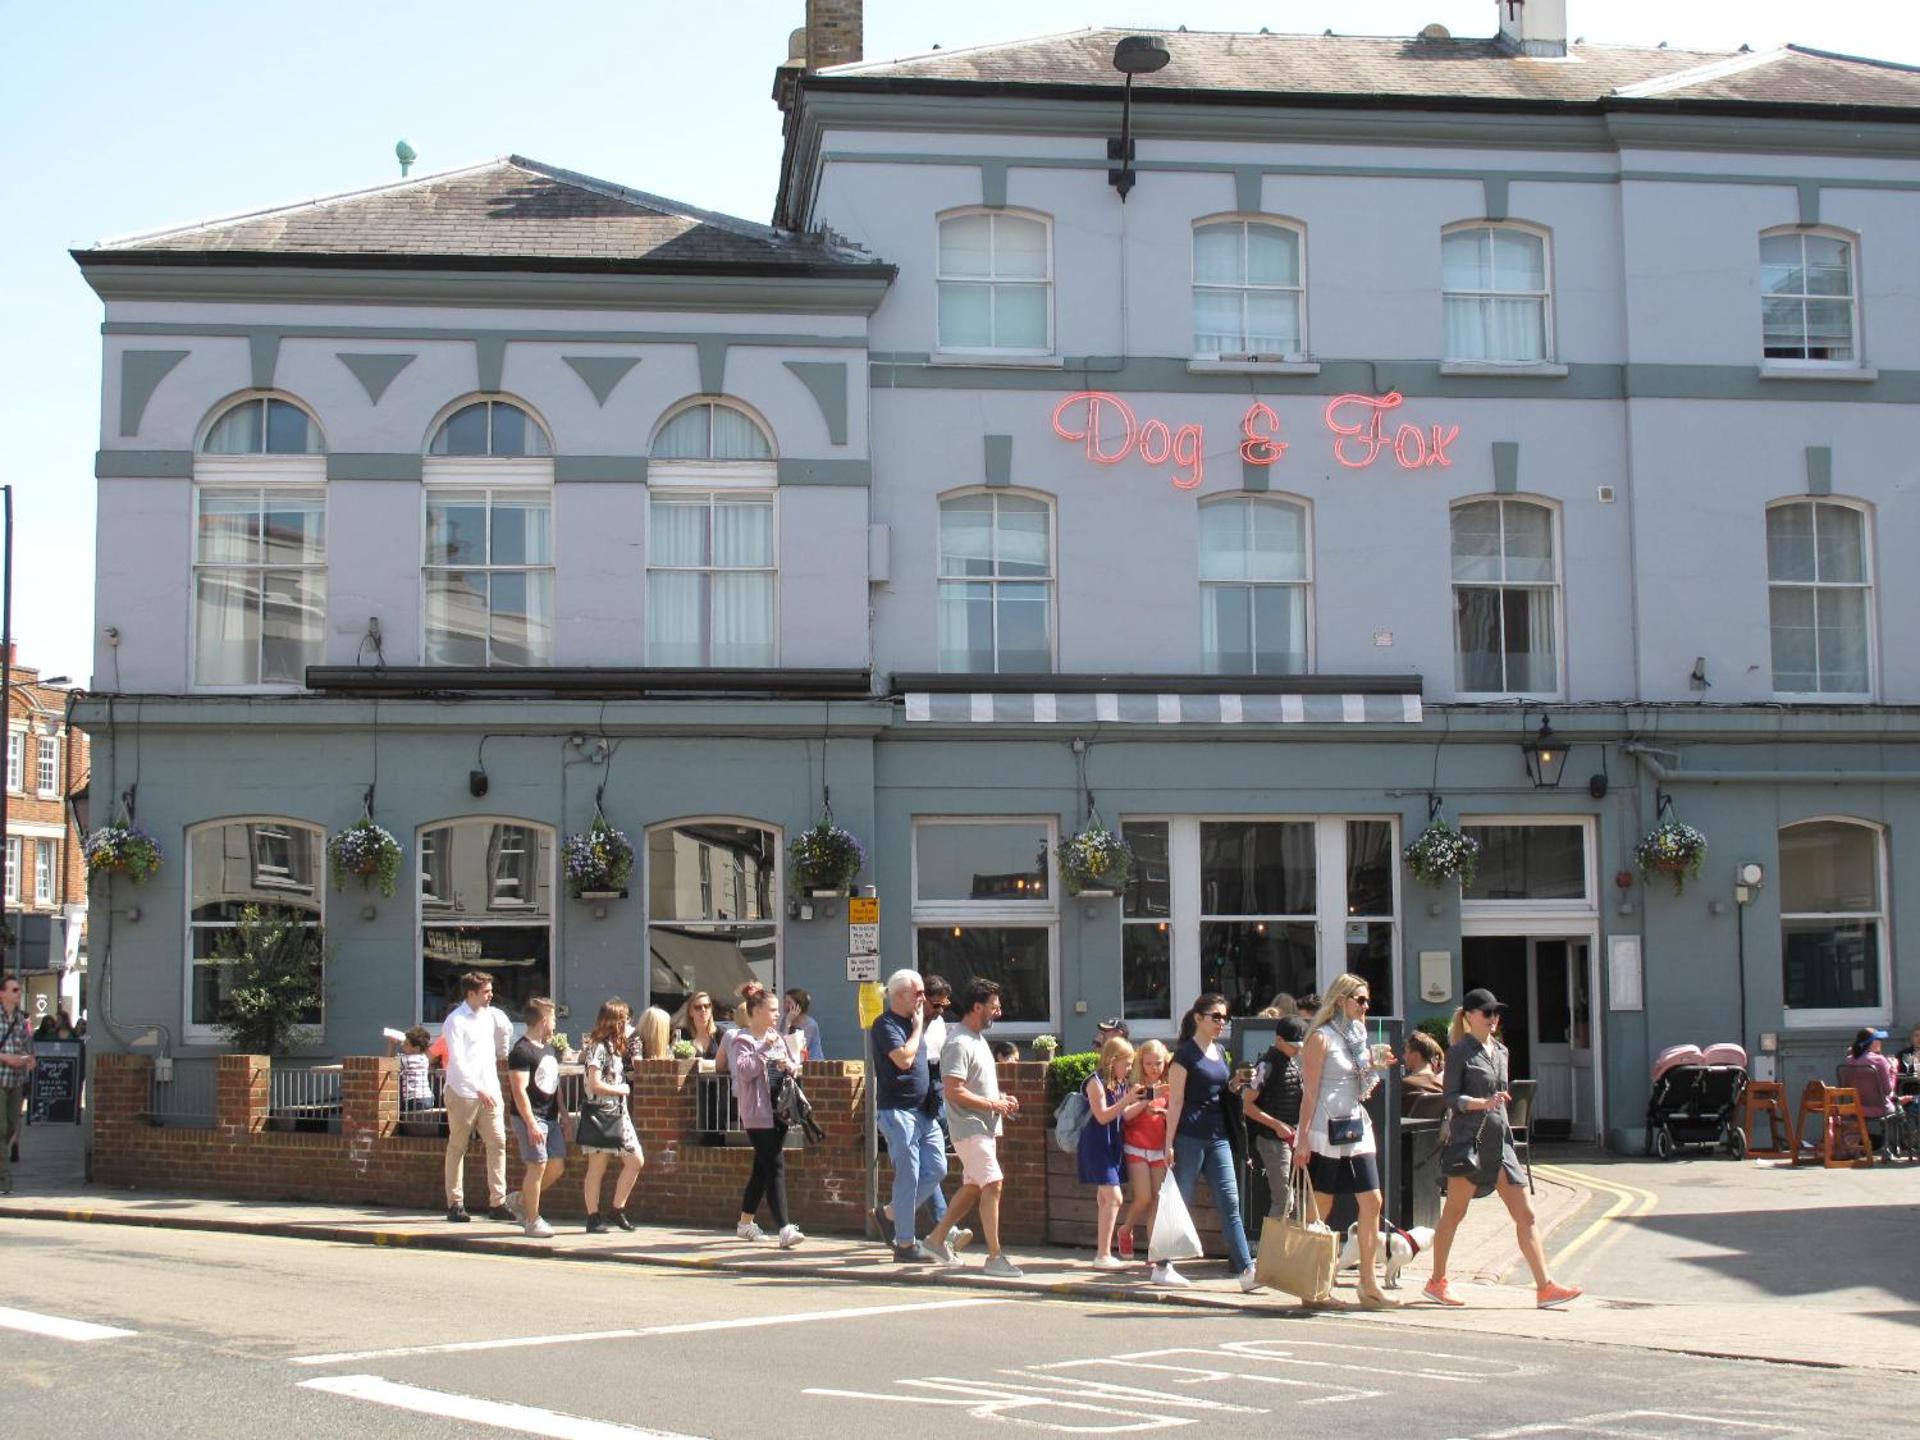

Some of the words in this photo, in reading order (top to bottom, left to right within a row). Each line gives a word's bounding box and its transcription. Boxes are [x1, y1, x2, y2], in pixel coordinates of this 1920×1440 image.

[1052, 391, 1203, 489] Dog
[1239, 402, 1289, 464] &
[1324, 391, 1461, 469] Fox
[800, 1340, 1552, 1433] CLEAR
